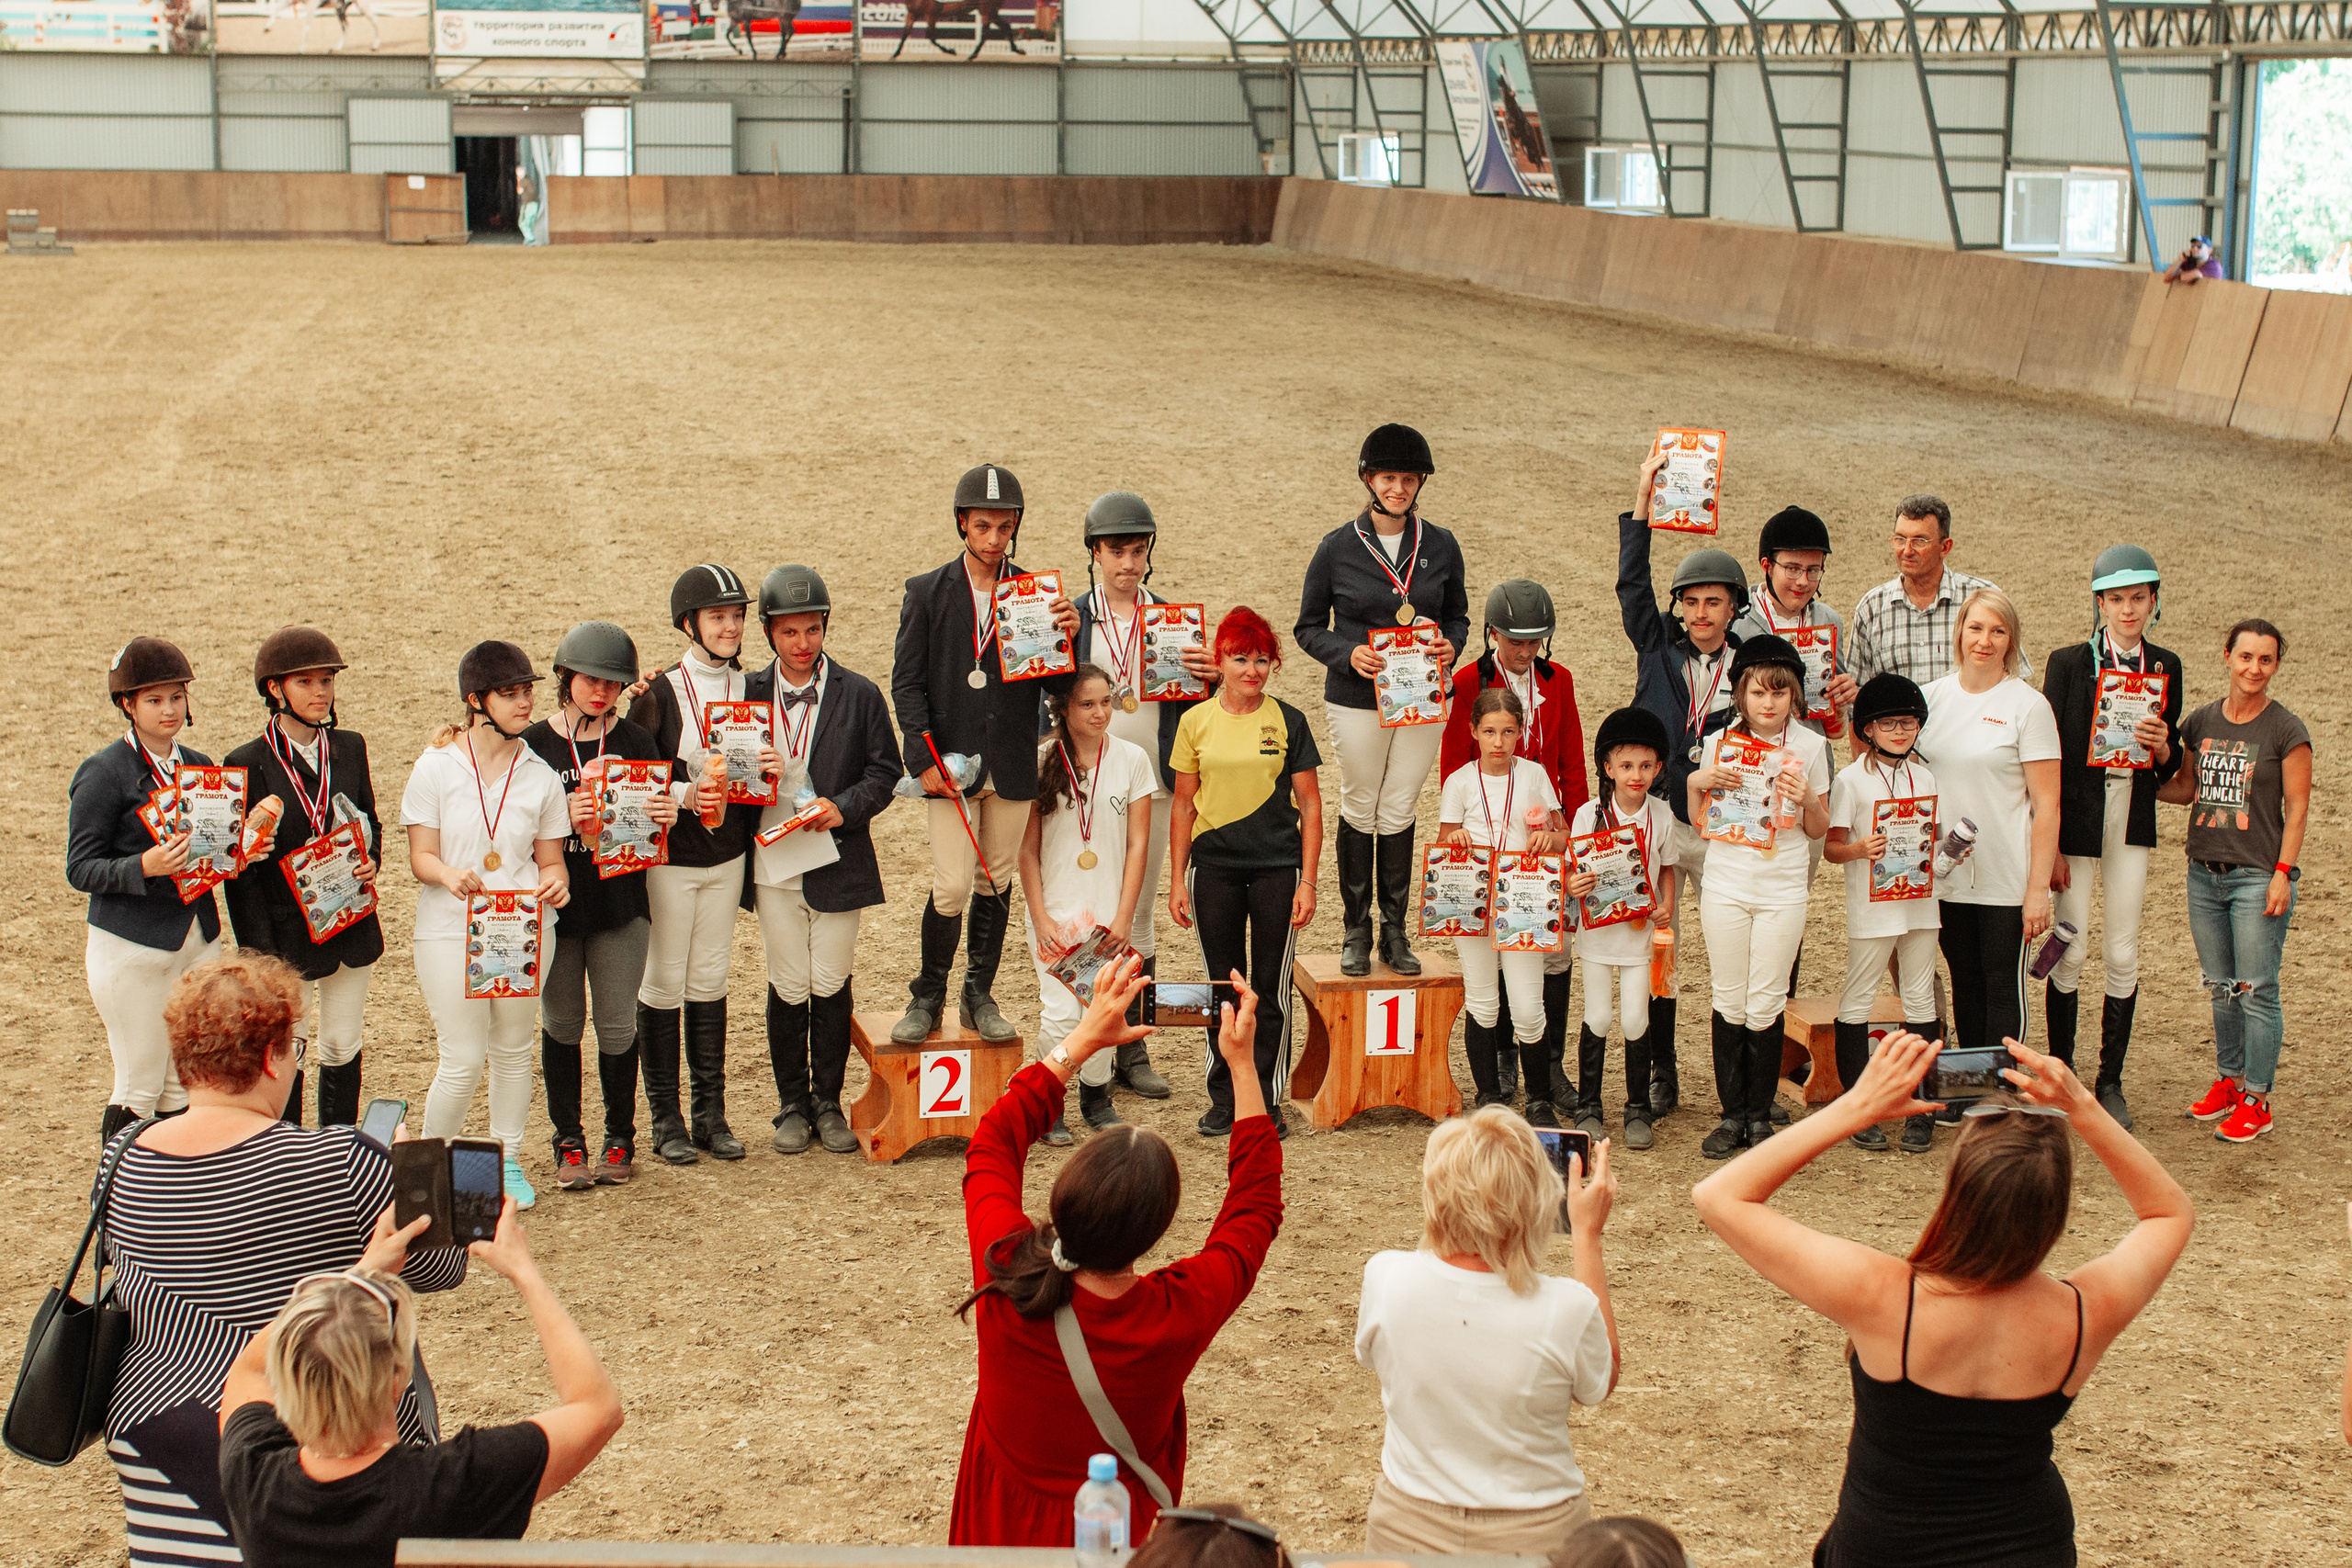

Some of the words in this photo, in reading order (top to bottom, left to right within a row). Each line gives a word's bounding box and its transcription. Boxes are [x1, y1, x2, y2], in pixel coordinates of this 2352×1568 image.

[473, 21, 545, 30] территория
[548, 22, 605, 31] развития
[492, 39, 541, 47] конного
[544, 39, 587, 48] спорта
[1011, 597, 1045, 606] ГРАМОТА
[1388, 649, 1420, 657] ГРАМОТА
[1732, 765, 1765, 776] ГРАМОТА
[2201, 754, 2247, 773] HEART
[2201, 769, 2216, 785] OF
[2218, 771, 2243, 787] THE
[2199, 785, 2243, 803] JUNGLE
[310, 852, 343, 872] ГРАМОТА
[1590, 849, 1623, 862] ГРАМОТА
[1376, 995, 1406, 1051] 1
[927, 1055, 964, 1112] 2
